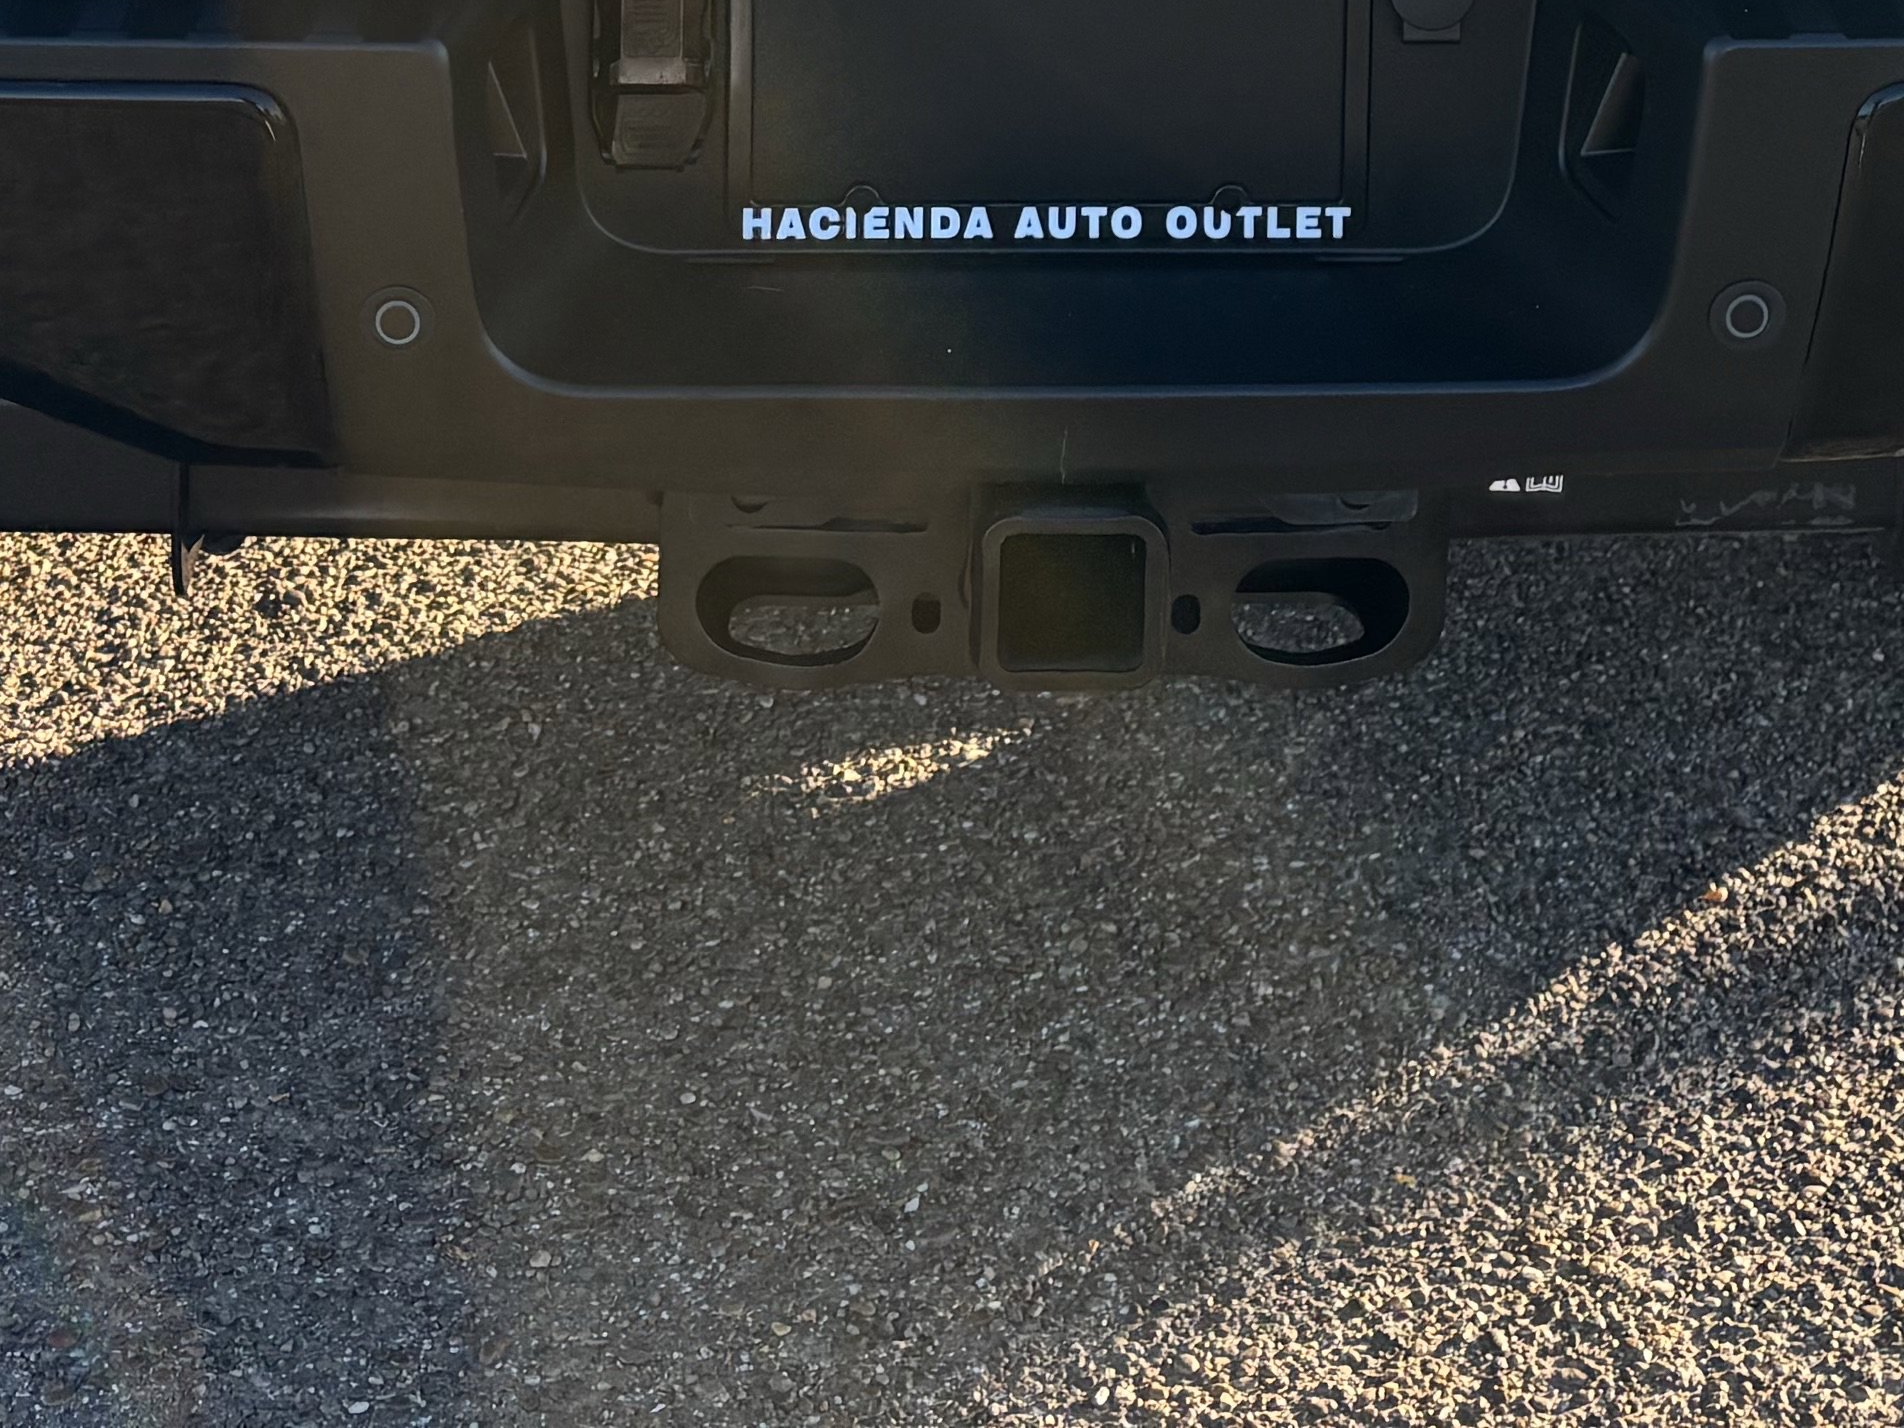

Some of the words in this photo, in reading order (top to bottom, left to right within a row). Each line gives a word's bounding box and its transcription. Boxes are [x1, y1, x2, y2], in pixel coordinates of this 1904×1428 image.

[741, 206, 994, 241] HACIENDA
[1013, 205, 1143, 240] AUTO
[1164, 205, 1352, 240] OUTLET
